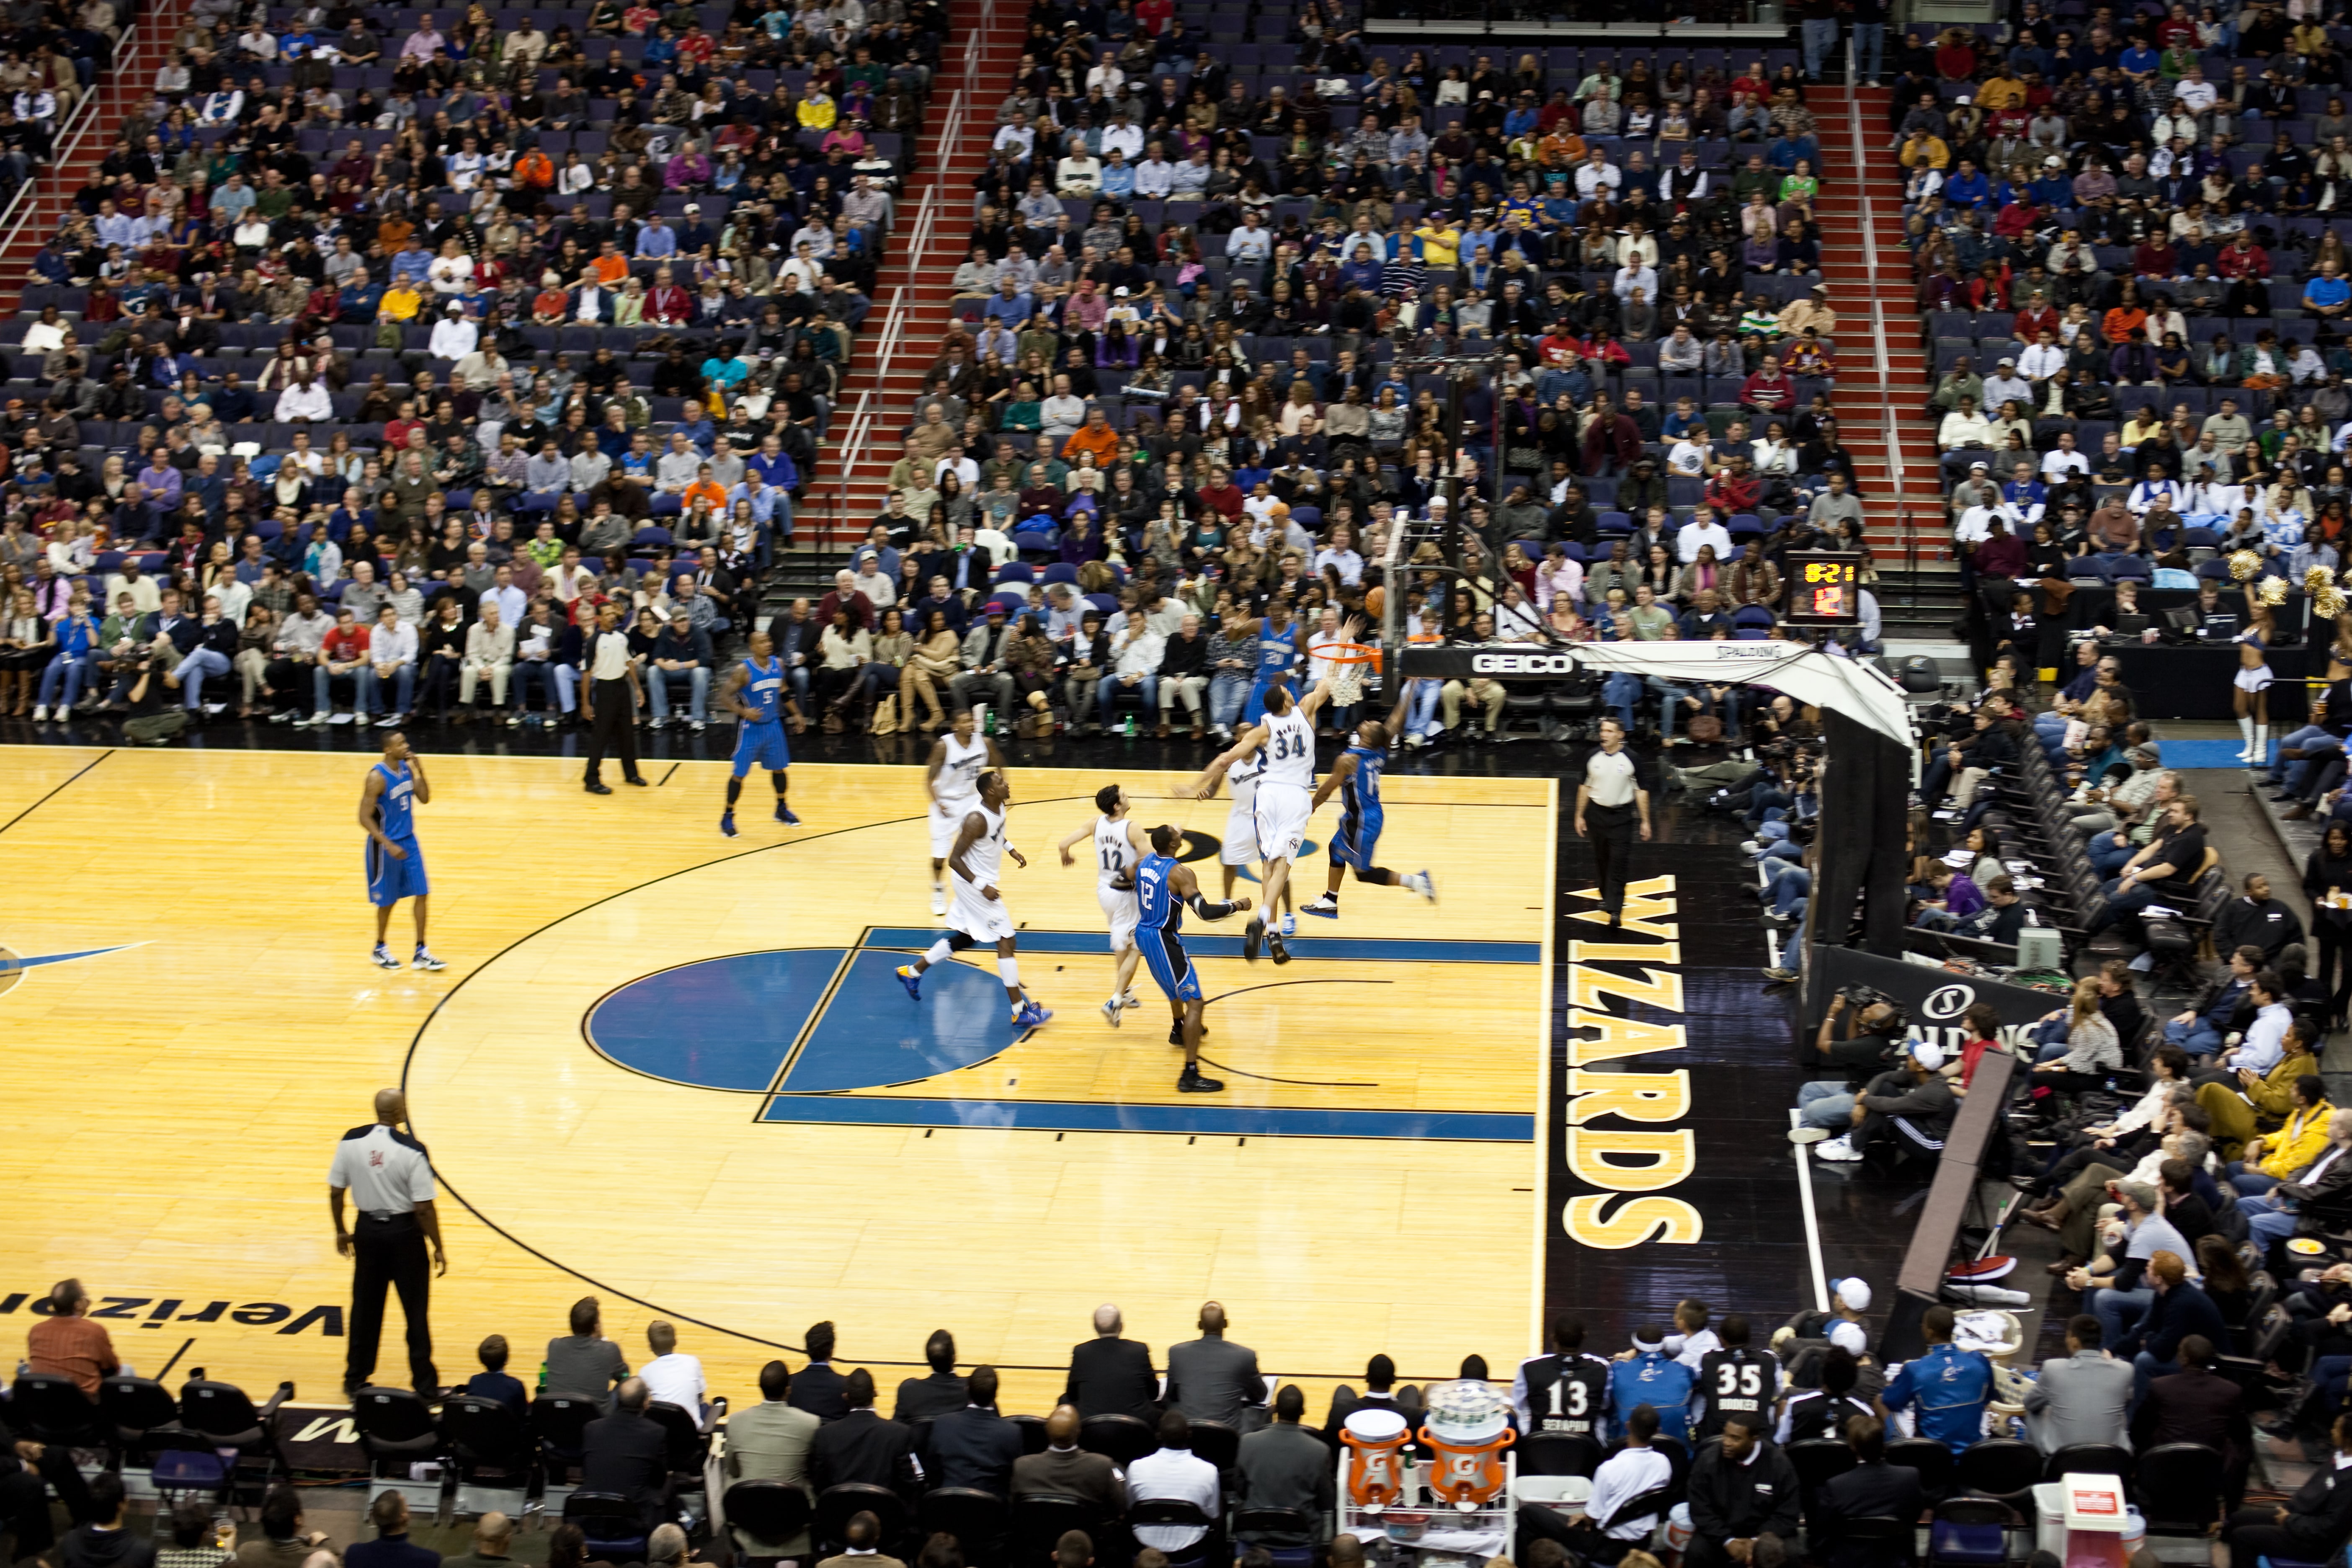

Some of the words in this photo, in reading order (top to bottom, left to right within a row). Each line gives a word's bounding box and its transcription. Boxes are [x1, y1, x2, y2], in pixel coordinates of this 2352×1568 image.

[1814, 586, 1842, 614] 12
[1472, 654, 1573, 673] GEICO
[1718, 645, 1781, 659] SPALDING
[763, 691, 773, 704] 5
[1275, 734, 1307, 760] 34
[1101, 847, 1126, 872] 12
[1140, 880, 1154, 910] 12
[1563, 874, 1703, 1249] WIZARDS
[1717, 1364, 1761, 1396] 35
[1547, 1380, 1588, 1416] 13
